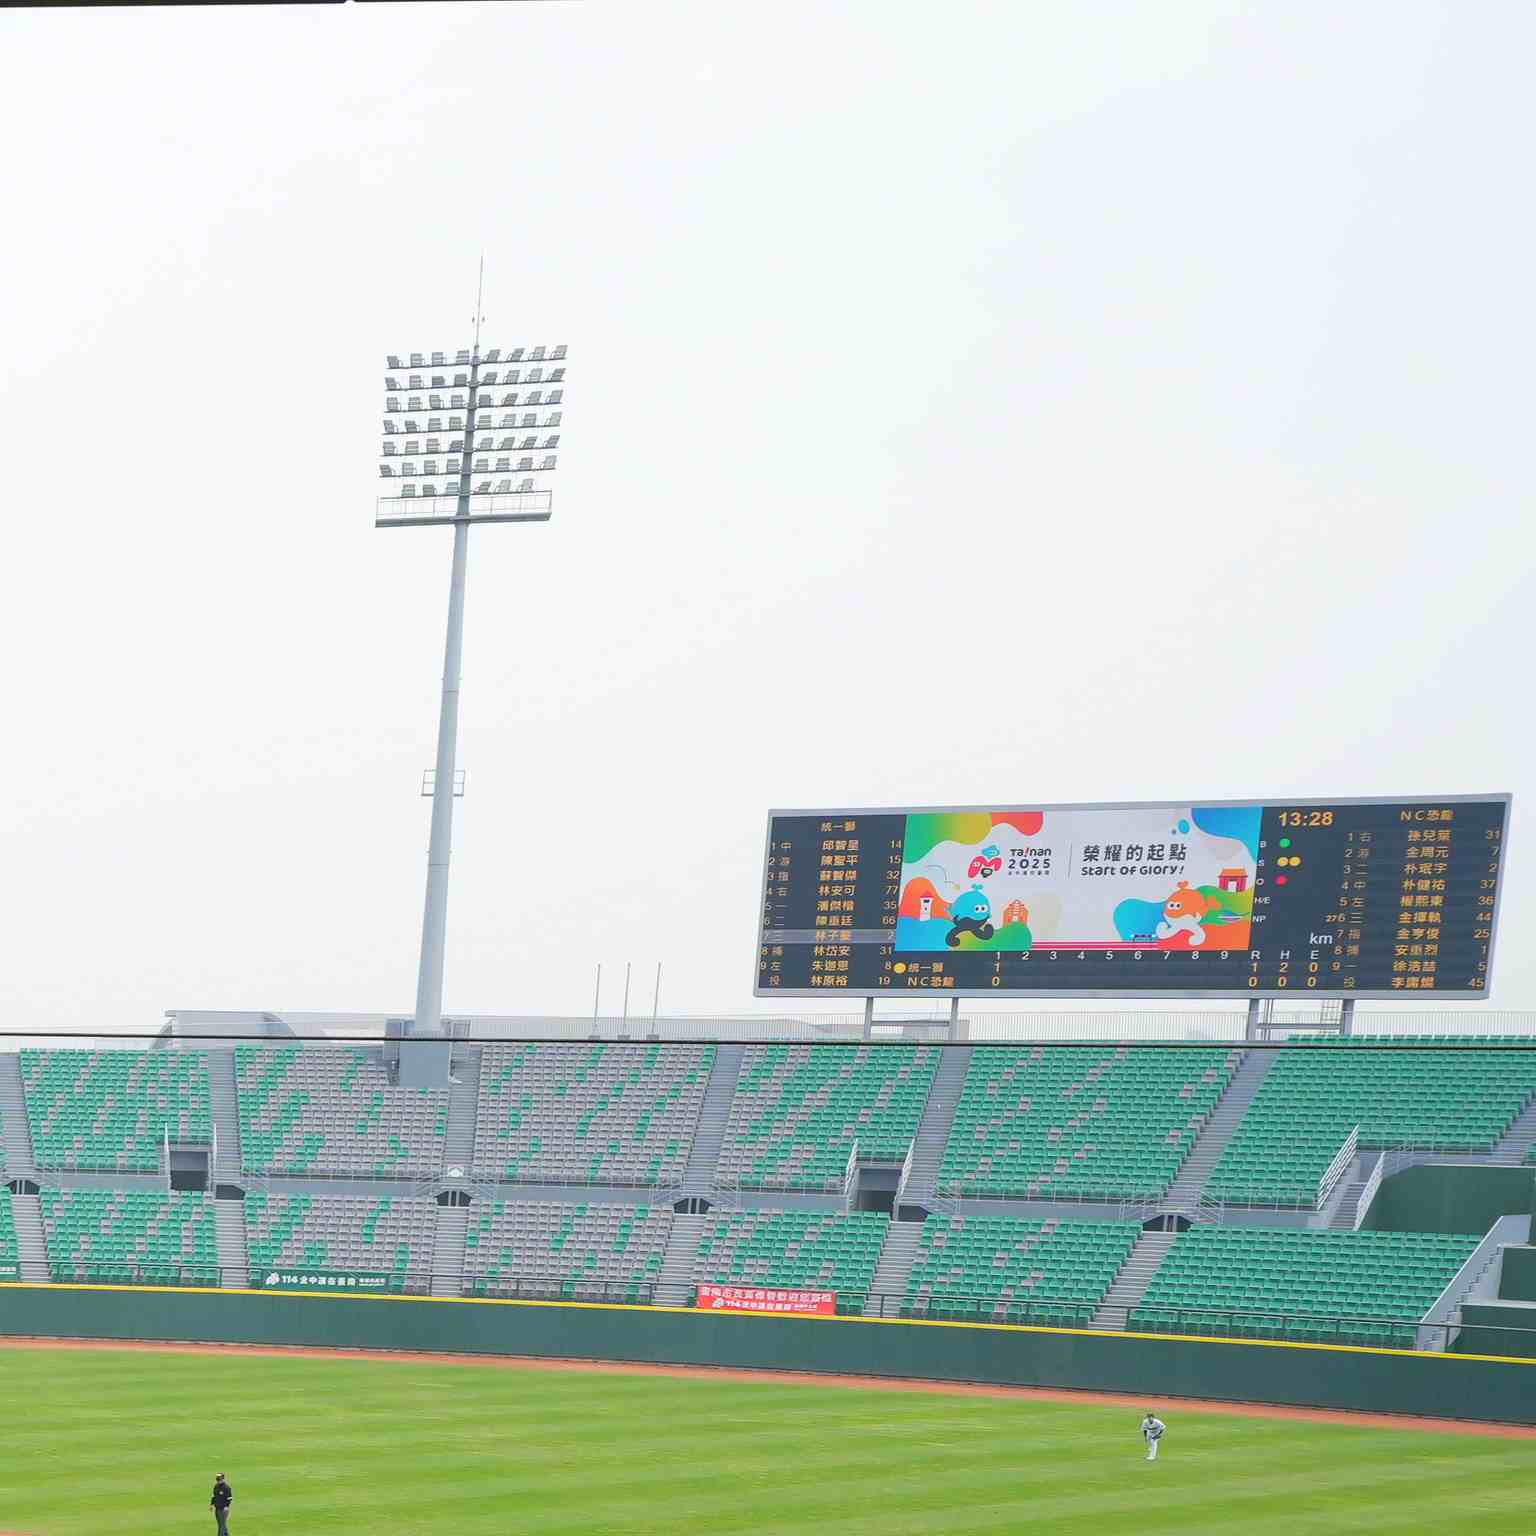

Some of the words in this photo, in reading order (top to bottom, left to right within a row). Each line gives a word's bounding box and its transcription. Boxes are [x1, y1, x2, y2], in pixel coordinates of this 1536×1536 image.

[1279, 812, 1334, 826] 13:28
[1348, 833, 1353, 841] 1
[1485, 830, 1500, 839] 31
[890, 840, 901, 848] 14
[1083, 843, 1186, 862] 榮耀的起點
[1344, 849, 1352, 857] 2
[1407, 847, 1448, 857] 金周元
[1493, 847, 1499, 856] 7
[1008, 859, 1050, 868] 2025
[1344, 865, 1351, 874] 3
[1355, 864, 1368, 875] 二
[1489, 864, 1497, 873] 2
[886, 871, 900, 879] 32
[1341, 881, 1348, 890] 4
[1354, 880, 1366, 890] 中
[1480, 880, 1495, 889] 37
[818, 886, 856, 896] 林安可
[1340, 897, 1347, 906] 5
[1478, 896, 1494, 906] 36
[775, 917, 784, 926] 二
[1253, 915, 1266, 923] NP
[1337, 913, 1345, 922] 6
[1349, 913, 1363, 923] 三
[1476, 913, 1491, 921] 44
[1310, 933, 1333, 944] km
[1337, 930, 1343, 939] 7
[1473, 929, 1489, 938] 25
[996, 951, 1000, 960] 1
[1022, 951, 1030, 960] 2
[1050, 951, 1057, 960] 3
[1077, 951, 1085, 960] 4
[1105, 951, 1113, 960] 5
[1134, 951, 1142, 960] 6
[1163, 951, 1170, 960] 7
[1192, 951, 1199, 960] 8
[1220, 951, 1228, 960] 9
[1252, 951, 1260, 959] R
[1280, 951, 1290, 959] H
[1311, 951, 1319, 959] E
[1334, 946, 1342, 955] 8
[1481, 946, 1487, 954] 1
[994, 962, 1000, 973] 1
[1252, 963, 1258, 972] 1
[1280, 963, 1287, 972] 2
[1310, 963, 1319, 972] 0
[1332, 962, 1340, 971] 9
[1478, 962, 1486, 971] 5
[991, 977, 1000, 986] 0
[1249, 978, 1258, 986] 0
[1278, 978, 1287, 986] 0
[1307, 977, 1316, 986] 0
[1468, 979, 1484, 987] 45
